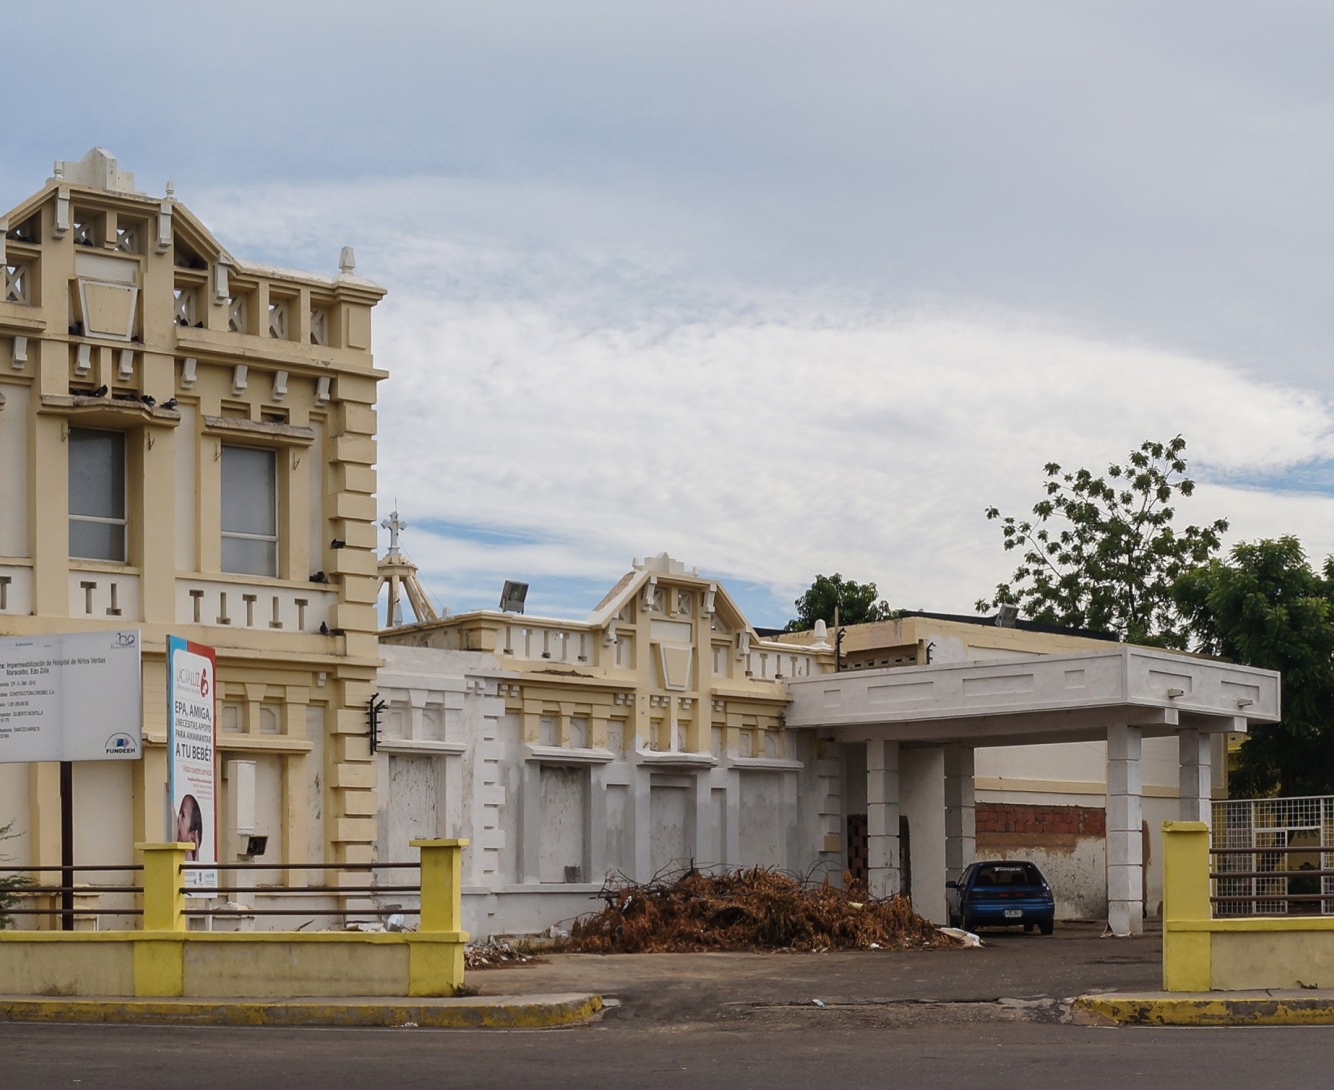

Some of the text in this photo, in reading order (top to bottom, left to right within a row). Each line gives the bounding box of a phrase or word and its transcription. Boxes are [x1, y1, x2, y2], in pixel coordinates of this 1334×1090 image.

[52, 658, 70, 667] Hospital
[175, 700, 212, 722] EPA, AMIGA,
[175, 743, 212, 762] A TU BEBÉ?
